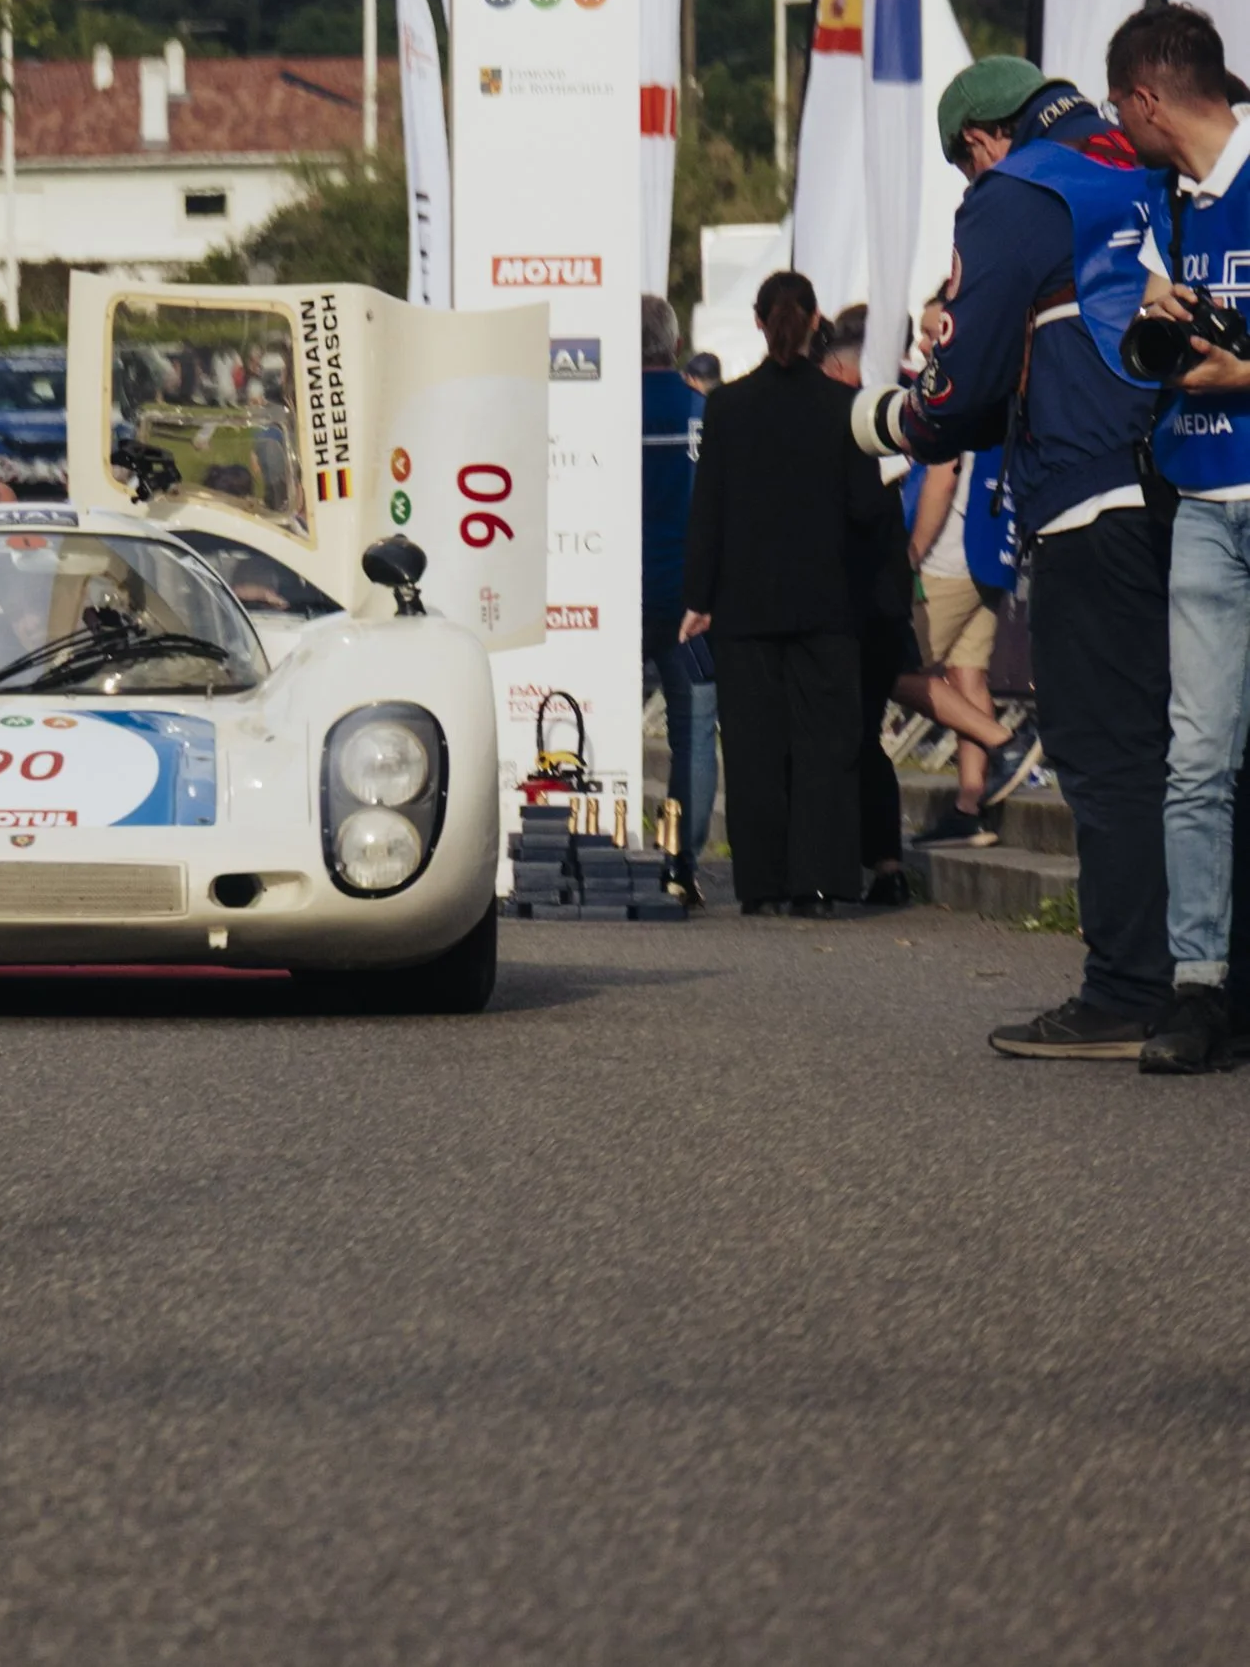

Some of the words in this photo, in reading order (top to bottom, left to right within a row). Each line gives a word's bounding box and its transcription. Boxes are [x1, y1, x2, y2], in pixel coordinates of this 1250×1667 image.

[496, 259, 598, 283] MOTUL
[1182, 253, 1209, 282] OUR
[300, 300, 330, 467] HERRMANN
[321, 294, 350, 463] NEERPASCH
[1173, 412, 1234, 435] MEDIA
[456, 464, 515, 548] 90
[547, 608, 592, 628] oint
